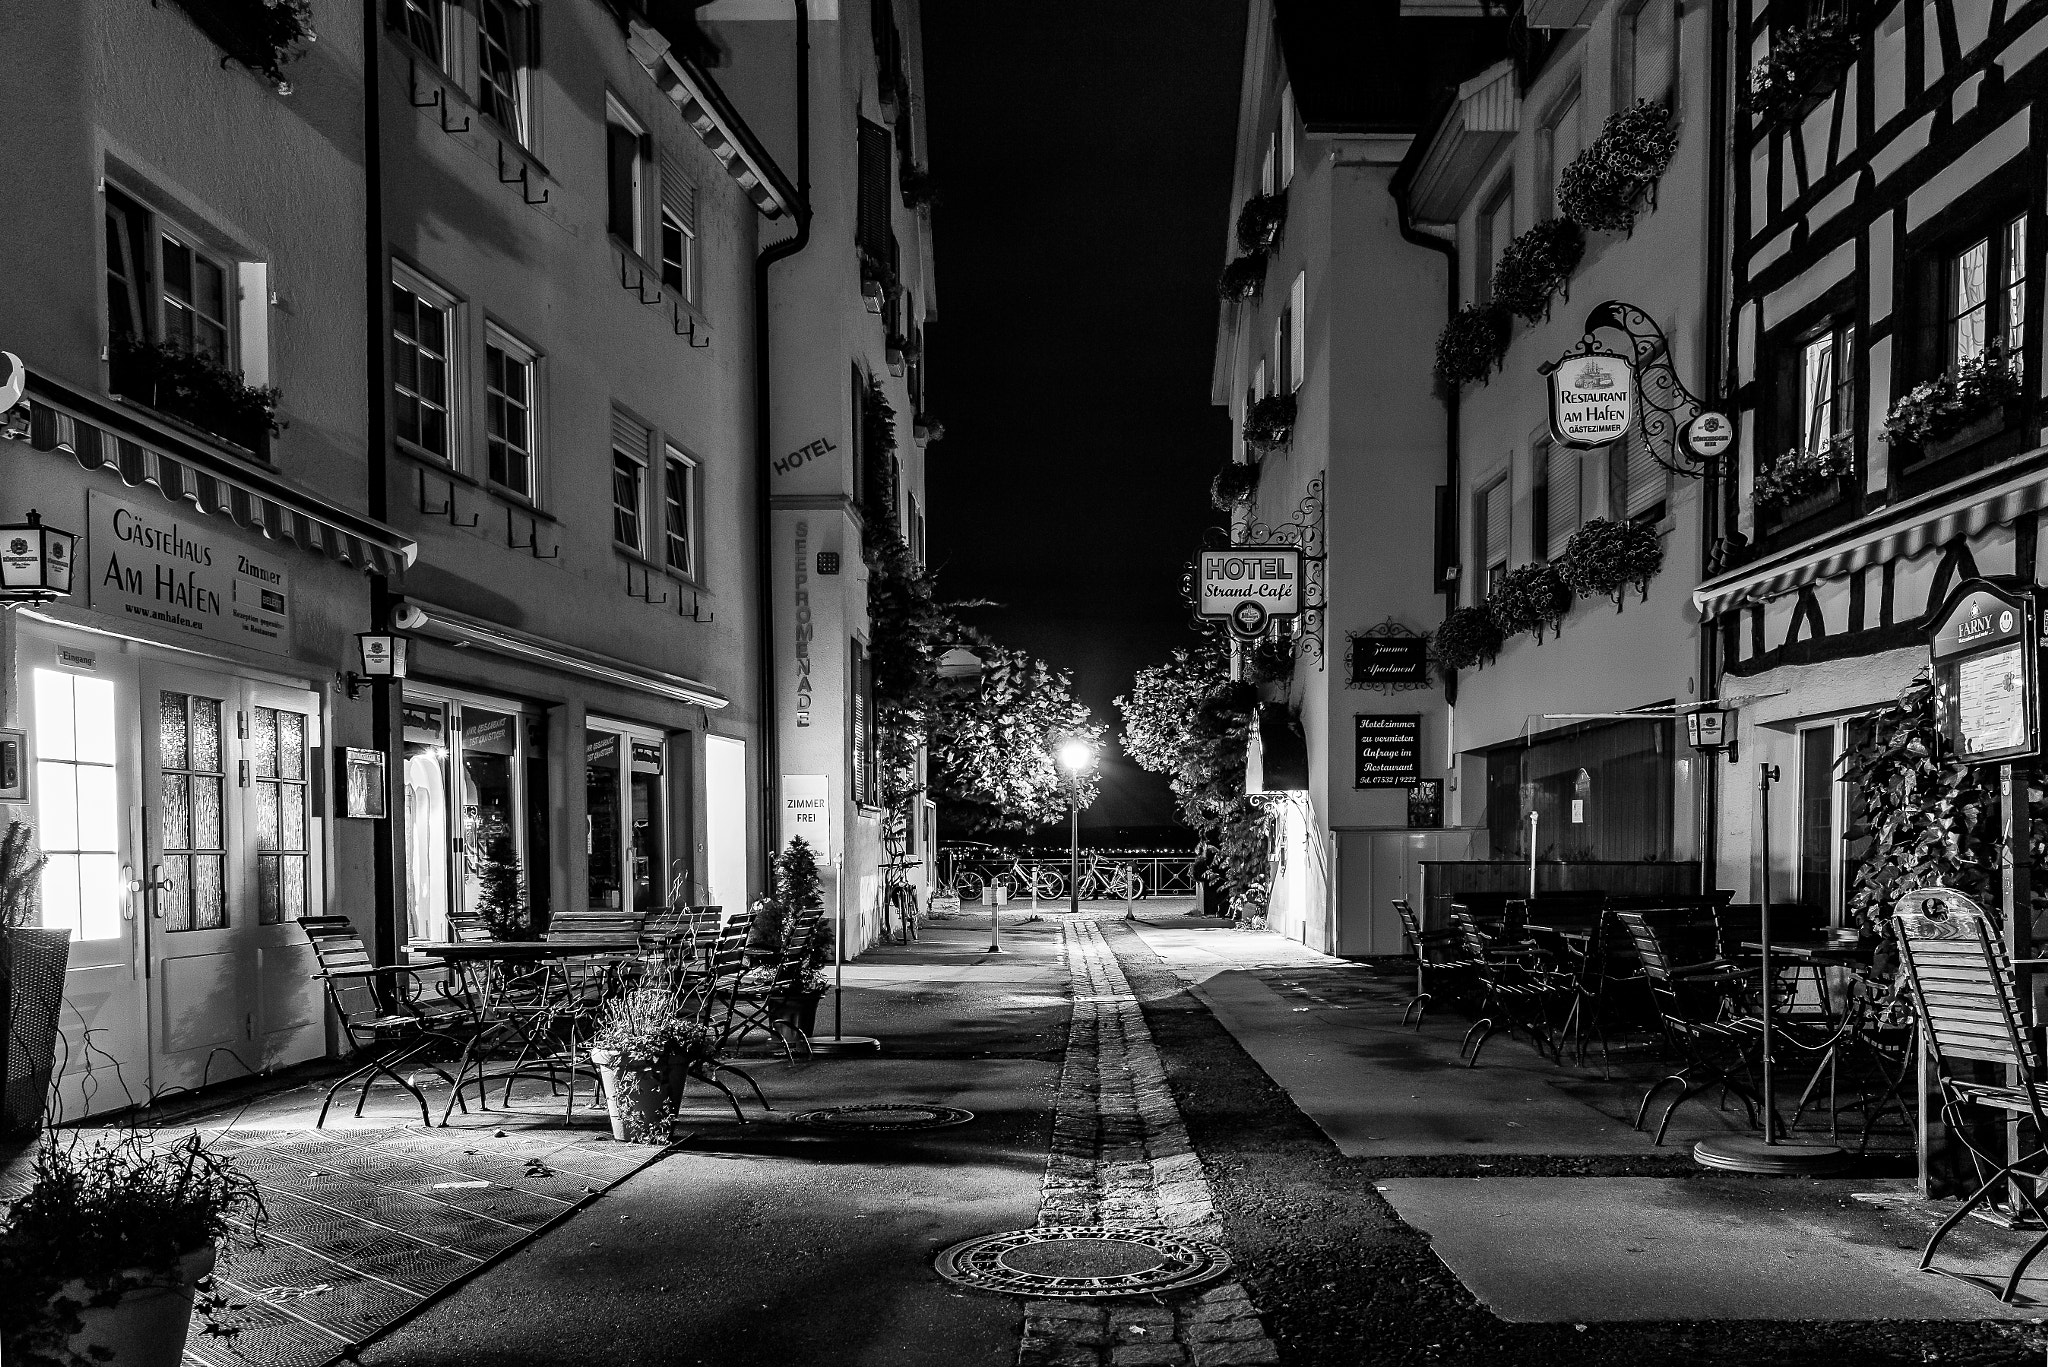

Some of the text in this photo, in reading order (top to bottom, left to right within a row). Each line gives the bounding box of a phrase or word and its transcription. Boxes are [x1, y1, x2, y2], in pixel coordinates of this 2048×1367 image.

[1561, 390, 1628, 404] RESTAURANT
[1563, 404, 1625, 423] AM HAFEN
[1568, 424, 1621, 433] GÄSTEZIMMER
[773, 437, 838, 476] HOTEL
[112, 508, 212, 567] GÄSTEHAUS
[237, 554, 281, 586] Zimmer
[1206, 557, 1293, 580] HOTEL
[103, 550, 220, 617] AM HAFEN
[1204, 583, 1293, 601] Strand-Café
[125, 603, 203, 631] www.amhafen.eu
[795, 521, 813, 728] SEEPROMENADE
[1958, 614, 1993, 638] FARNY
[1373, 642, 1409, 657] Zimmer
[62, 650, 92, 667] Eingang
[1367, 663, 1417, 677] Apartment
[1359, 719, 1416, 728] Hotelzimmer
[1374, 734, 1414, 743] vermieten
[1362, 747, 1412, 759] Anfrage im
[1363, 762, 1414, 772] Restaurant
[1359, 776, 1372, 784] Tel.
[1372, 776, 1394, 784] 07532
[787, 798, 825, 809] ZIMMER
[796, 813, 816, 823] FREI
